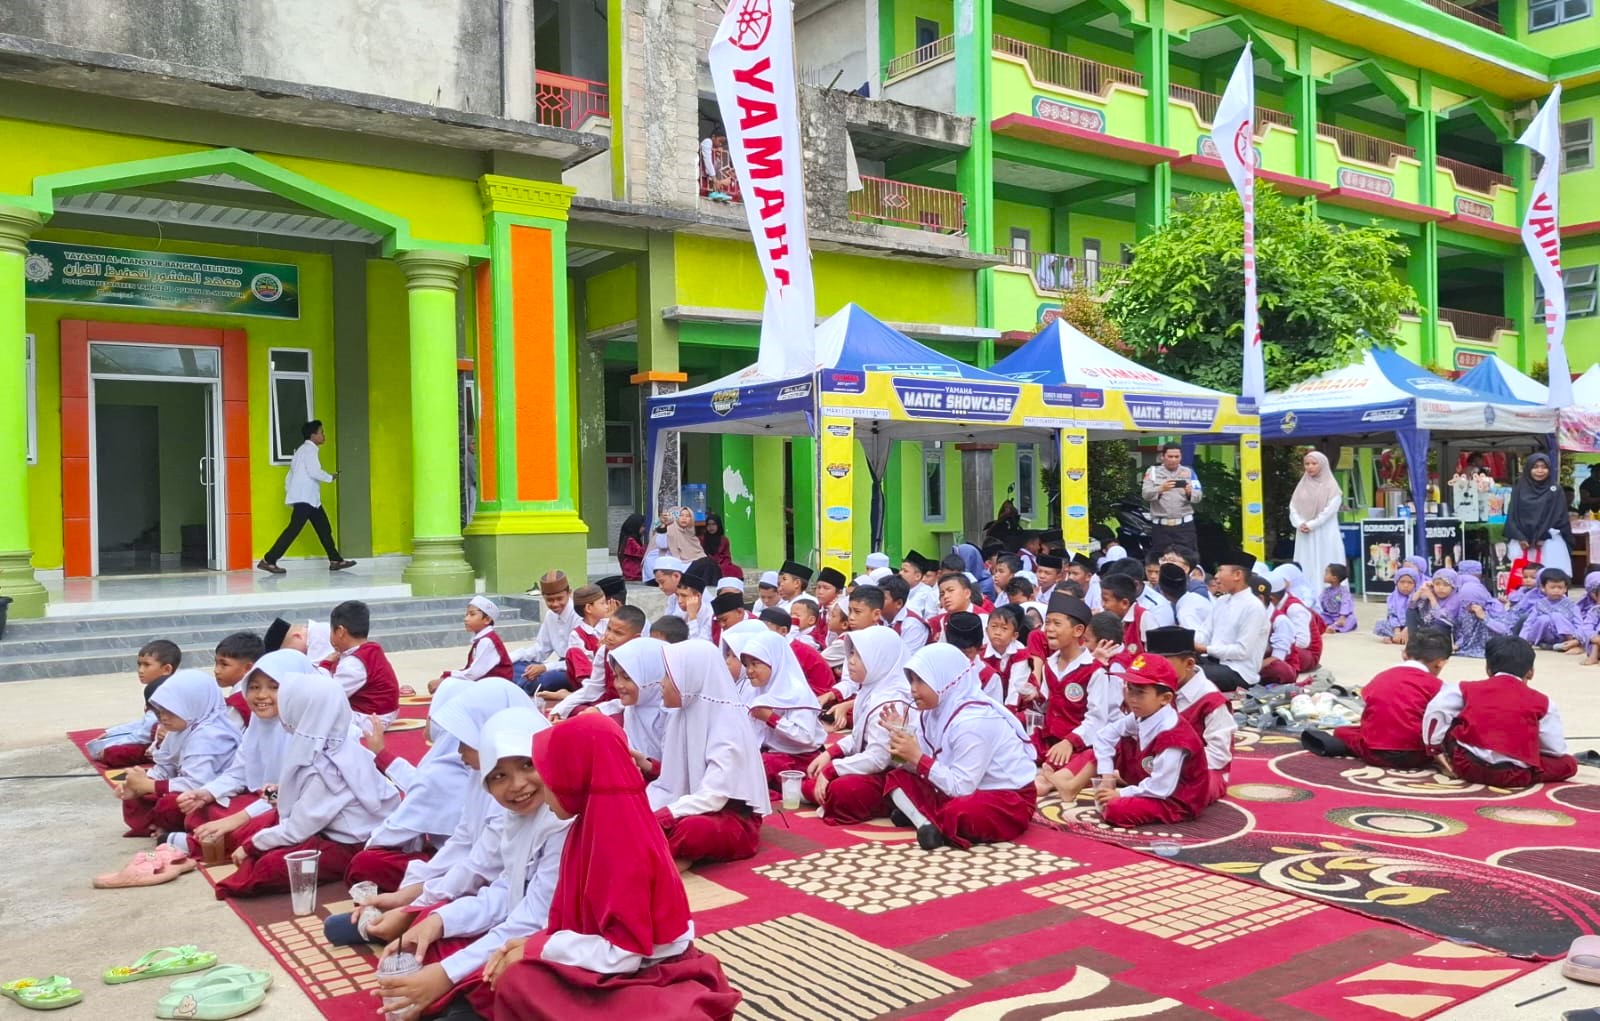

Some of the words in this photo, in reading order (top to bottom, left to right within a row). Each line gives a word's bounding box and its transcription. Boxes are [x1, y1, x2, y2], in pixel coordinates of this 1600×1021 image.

[63, 251, 105, 262] YAYASAN
[165, 261, 201, 271] BANGKA
[202, 264, 243, 275] BELITUNG
[783, 384, 808, 393] BLUE
[944, 386, 973, 394] YAMAHA
[903, 392, 942, 408] MATIC
[946, 394, 1012, 412] SHOWCASE
[1132, 406, 1161, 419] MATIC
[1164, 407, 1214, 421] SHOWCASE
